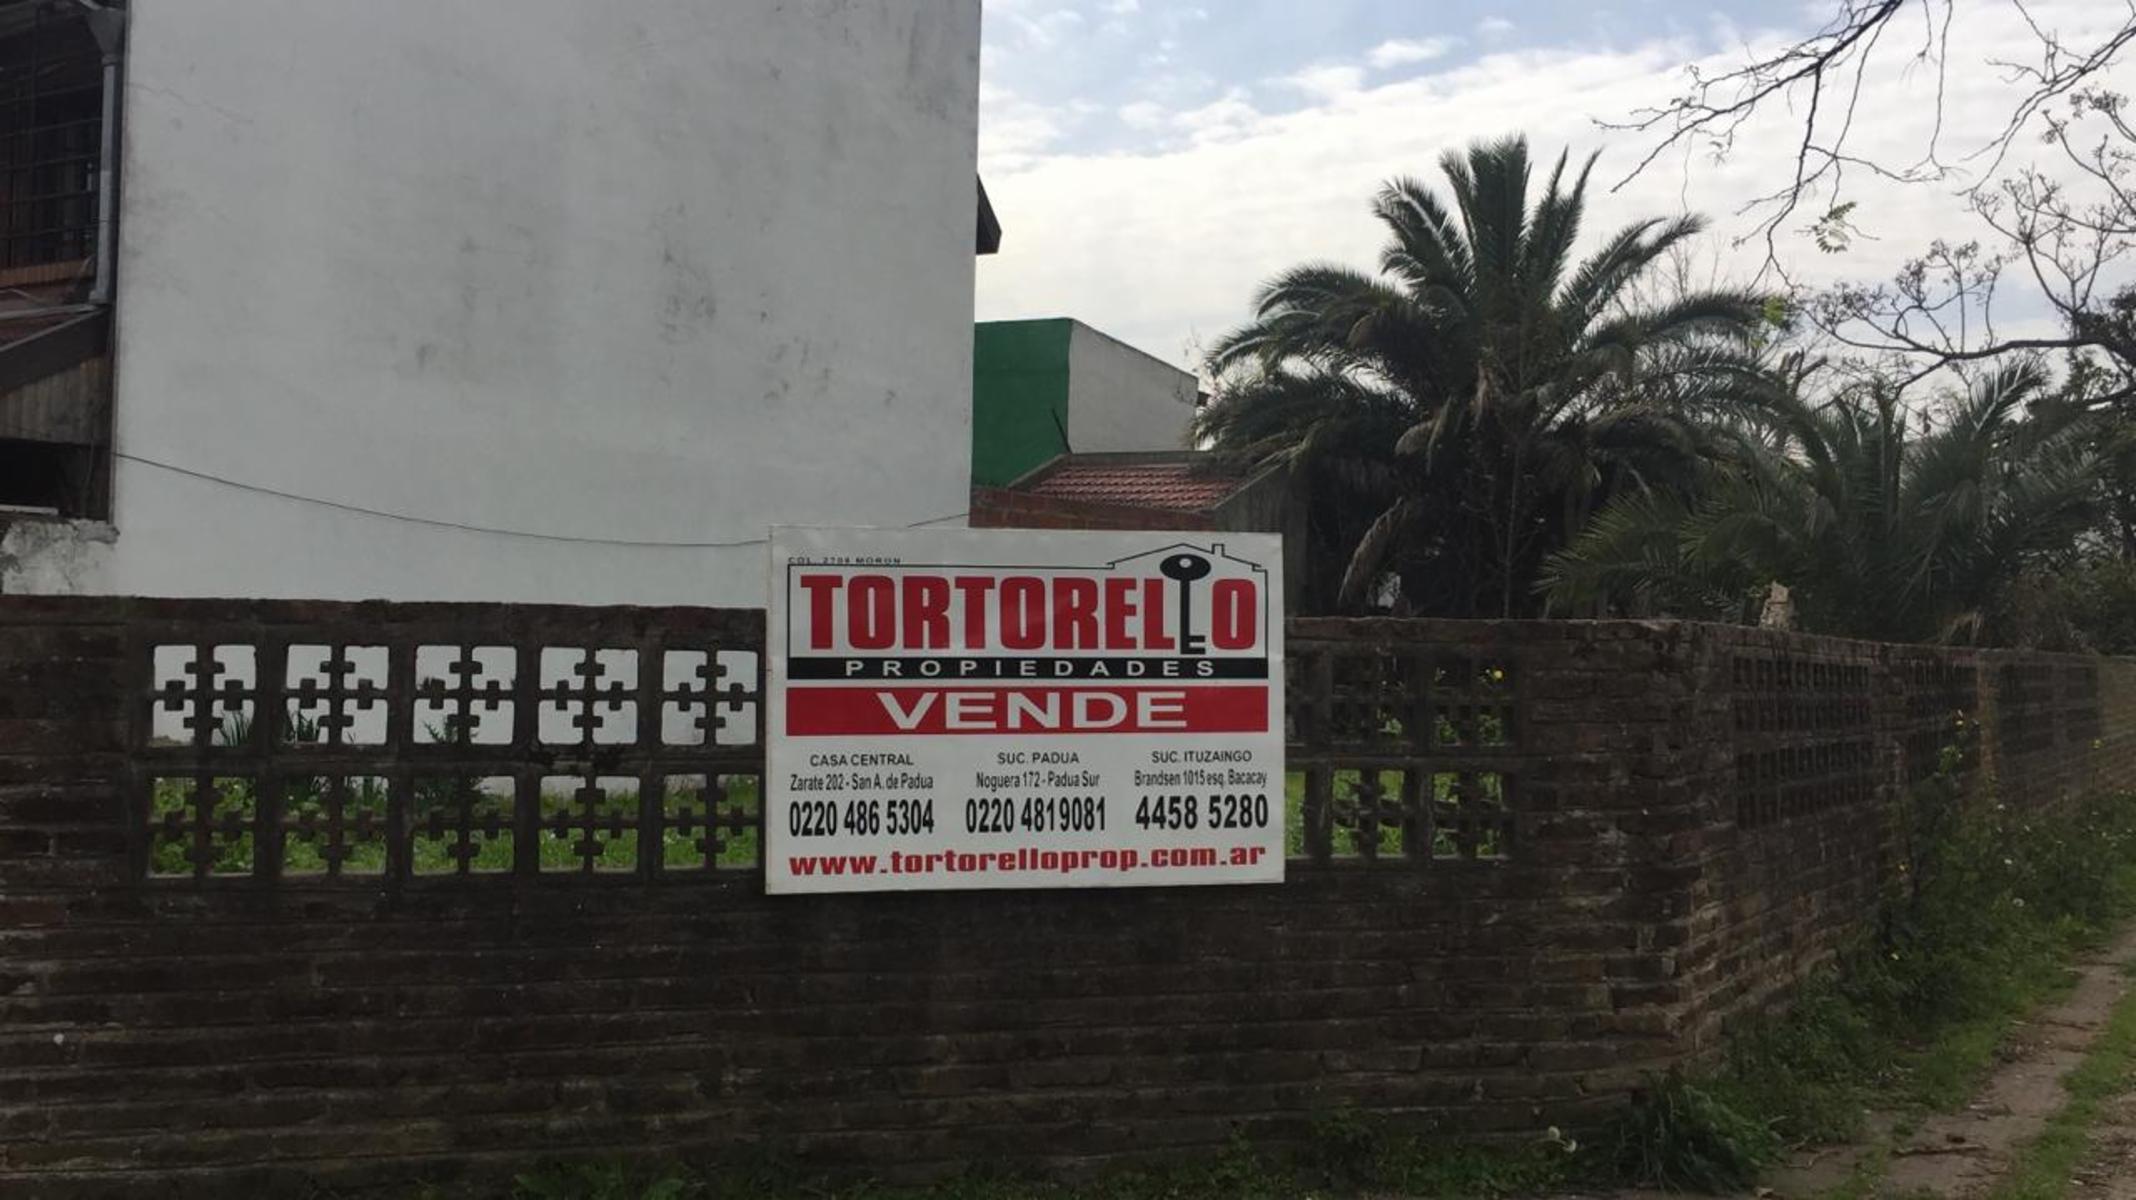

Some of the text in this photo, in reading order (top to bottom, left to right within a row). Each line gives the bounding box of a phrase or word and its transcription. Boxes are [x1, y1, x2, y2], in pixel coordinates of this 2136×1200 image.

[800, 574, 1256, 655] TORTORELLO
[845, 660, 1215, 677] PROPIEDADES
[876, 691, 1188, 729] VENDE
[810, 754, 914, 767] CASA CENTRAL
[1032, 752, 1080, 764] PADUA
[1184, 750, 1252, 763] ITUZAINGO
[790, 773, 823, 791] Zarate
[826, 773, 844, 791] 202
[852, 773, 872, 790] San
[886, 772, 898, 790] de
[901, 771, 933, 789] Padua
[976, 771, 1020, 792] Noguera
[1022, 771, 1040, 788] 172
[1047, 770, 1080, 787] Padua
[1082, 770, 1100, 787] Sur
[1134, 769, 1180, 787] Brandsen
[1183, 769, 1206, 786] 1015
[1228, 768, 1267, 789] Bacacay
[789, 799, 934, 837] 0220 486 5304
[966, 796, 1105, 834] 0220 4819081
[1135, 794, 1268, 830] 4458 5280
[789, 847, 1265, 875] www.tortorelloprop.com.ar
